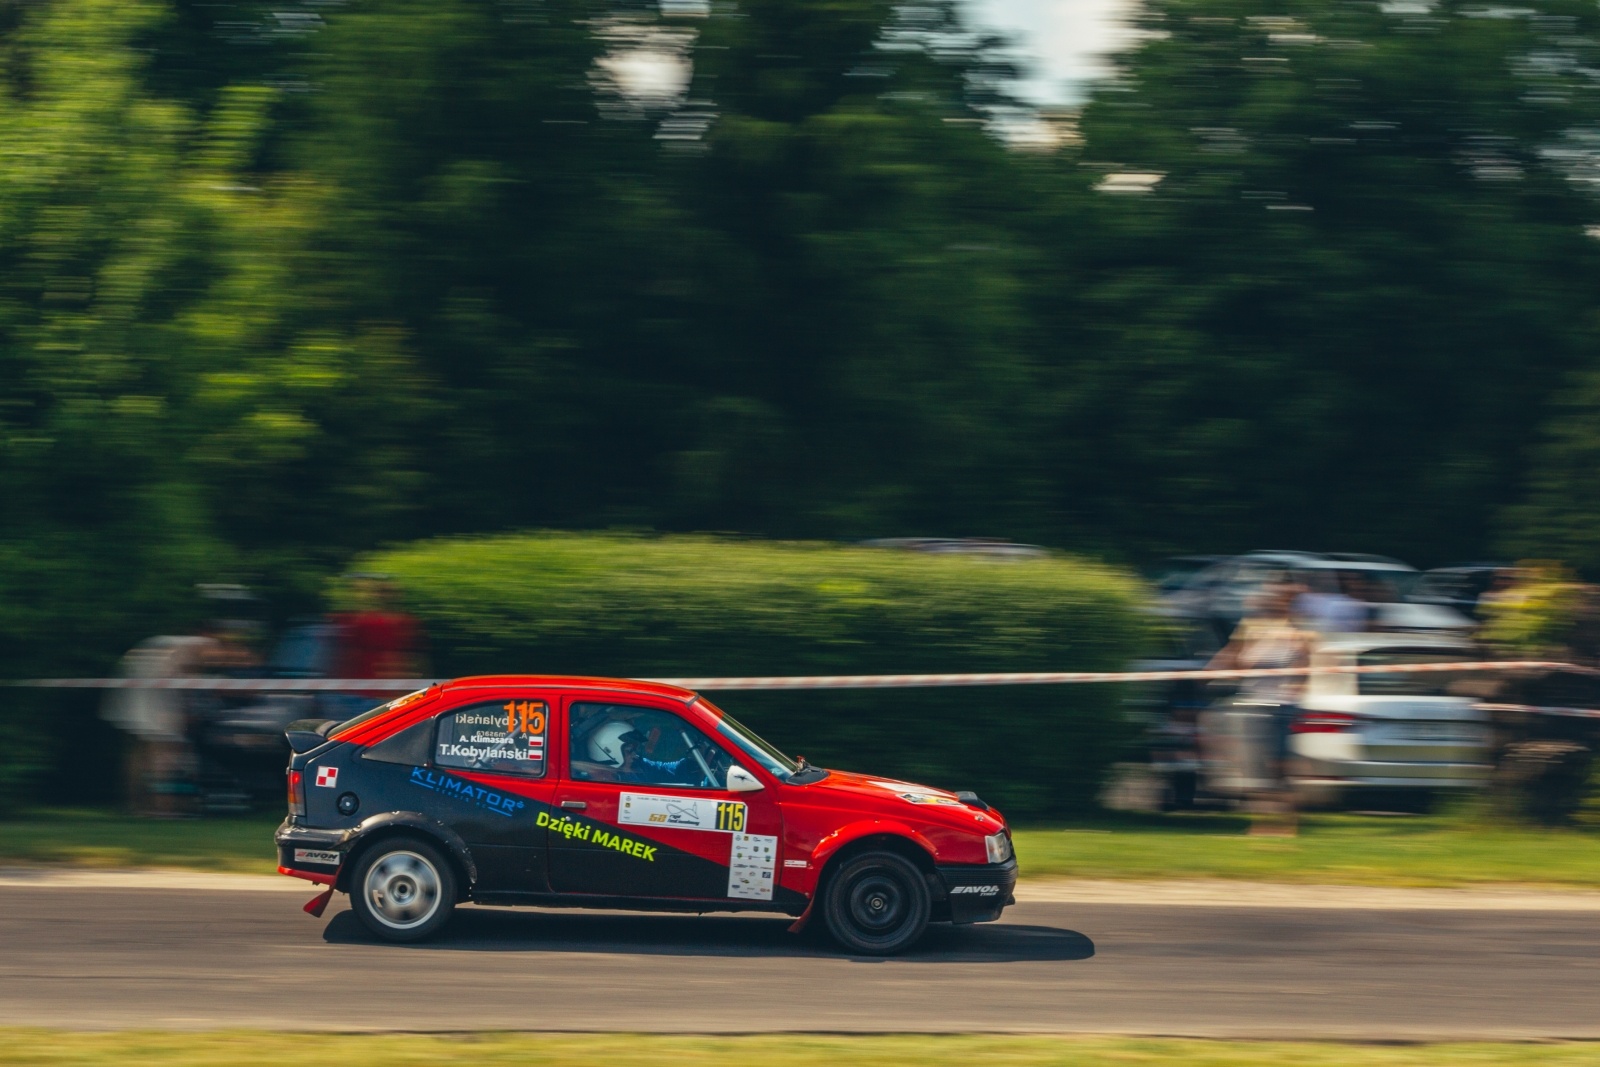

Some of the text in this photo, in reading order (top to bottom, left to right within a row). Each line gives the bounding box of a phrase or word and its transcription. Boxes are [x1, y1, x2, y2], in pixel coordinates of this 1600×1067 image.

[504, 701, 545, 734] 115
[439, 743, 528, 760] T.Kobylański
[459, 735, 514, 744] A. Klimasara
[412, 766, 516, 812] KLIMATOR
[717, 802, 744, 832] 115
[535, 811, 658, 862] Dzięki MAREK
